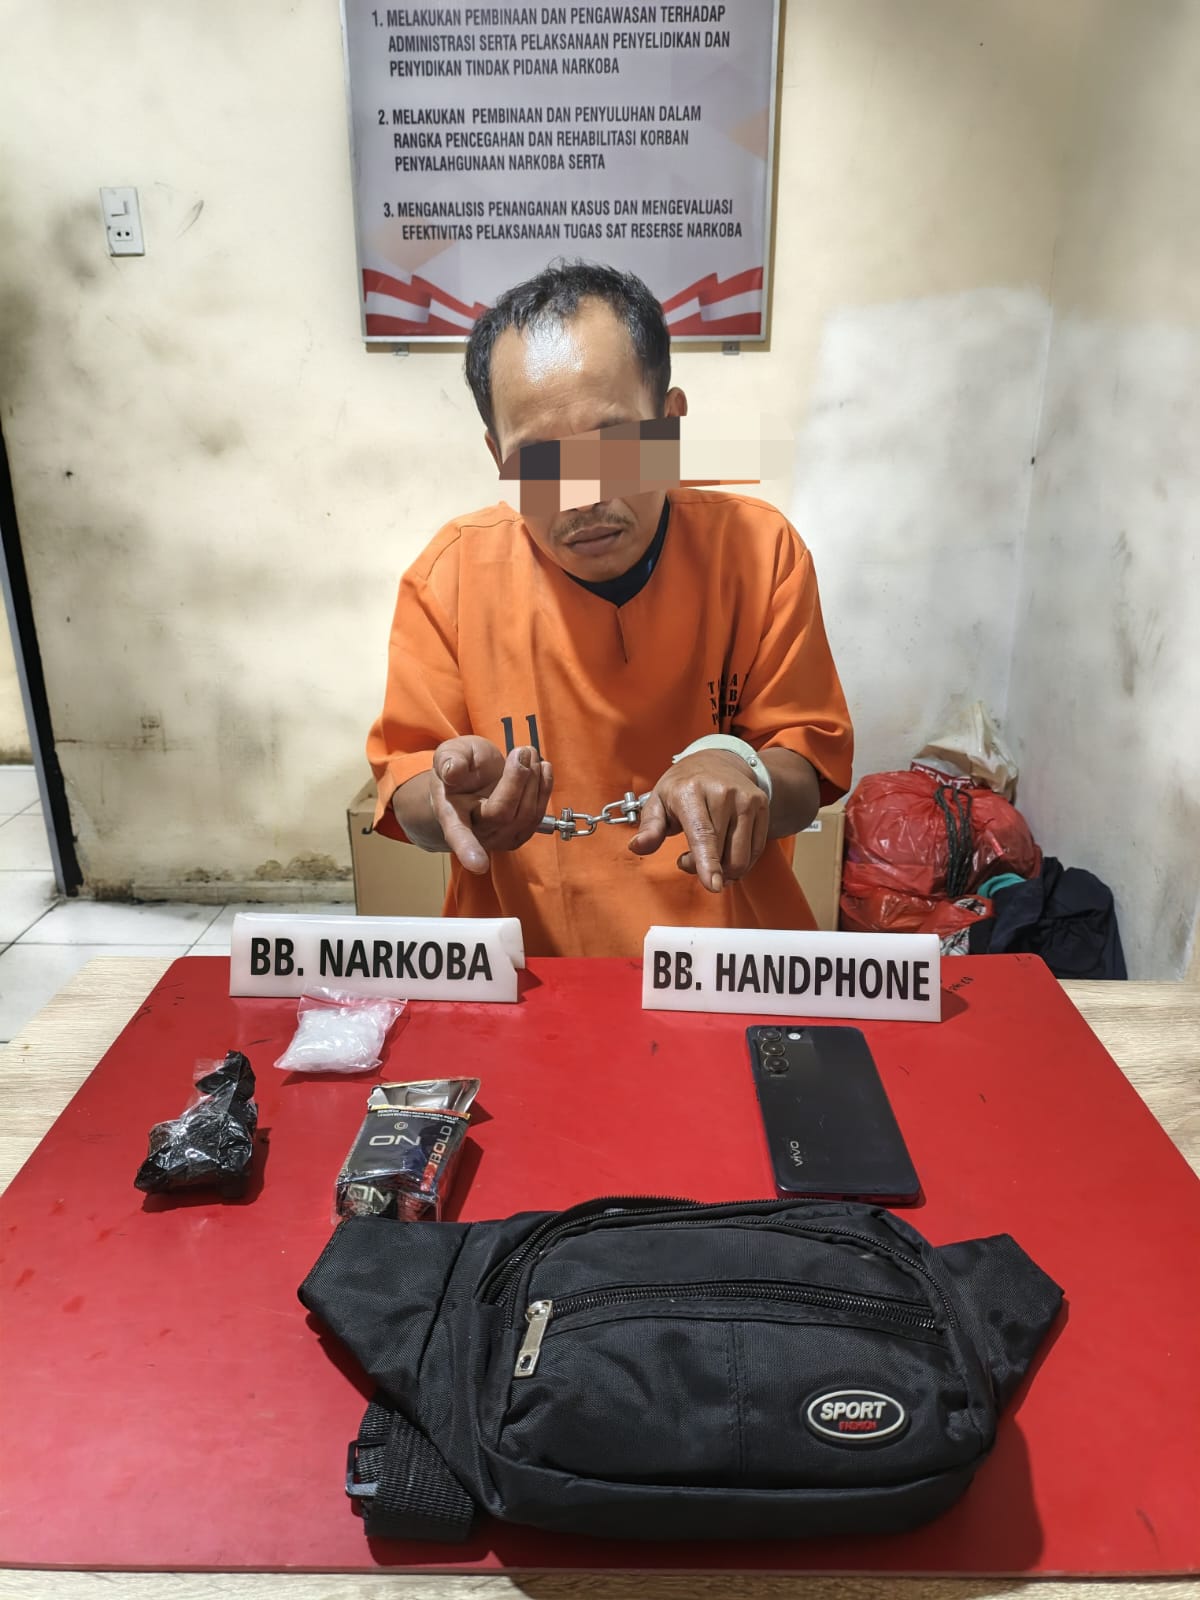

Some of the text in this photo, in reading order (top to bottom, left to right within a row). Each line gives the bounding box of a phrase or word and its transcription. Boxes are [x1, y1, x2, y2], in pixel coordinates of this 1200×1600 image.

[372, 5, 725, 27] 1. MELAKUKAN PEMBINAAN DAN PENGAWASAN TERHADAP
[389, 31, 729, 52] ADMINISTRASI SERTA PELAKSANAAN PENYELIDIKAN DAN
[390, 58, 619, 77] PENYIDIKAN TINDAK PIDANA NARKOBA
[378, 105, 701, 125] 2. MELAKUKAN PEMBINAAN DAN PENYULUHAN DALAM
[394, 130, 688, 148] RANGKA PENCEGAHAN DAN REHABILITASI KORBAN
[395, 154, 605, 171] PENYALAHGUNAAN NARKOBA SERTA
[384, 199, 732, 218] 3. MENGANALISIS PENANGANAN KASUS DAN MENGEVALUASI
[403, 222, 742, 240] EFEKTIVITAS PELAKSANAAN TUGAS SAT RESERSE NARKOBA
[250, 937, 493, 981] BB. NARKOBA
[653, 951, 930, 1001] BB. HANDPHONE
[369, 1135, 421, 1146] ON
[429, 1125, 453, 1163] BOLD
[820, 1401, 887, 1420] SPORT
